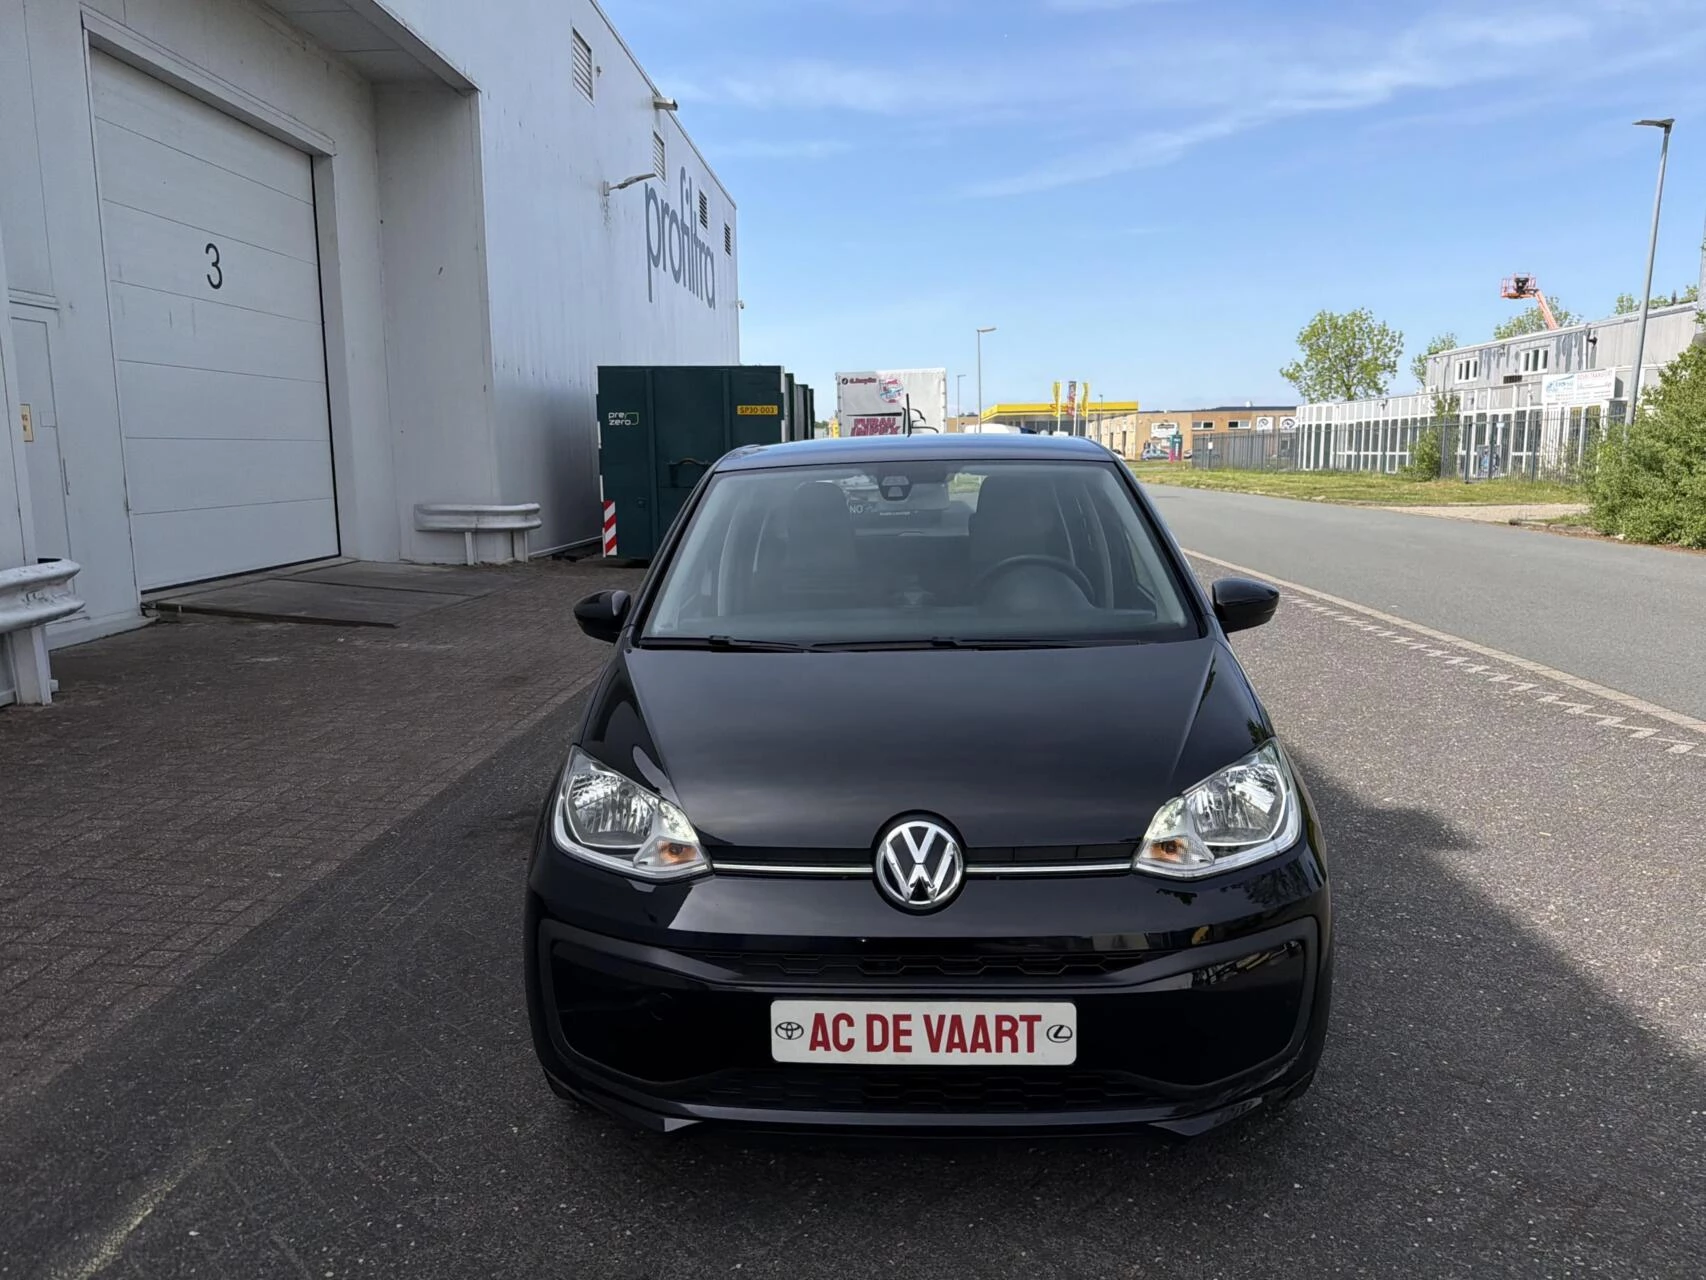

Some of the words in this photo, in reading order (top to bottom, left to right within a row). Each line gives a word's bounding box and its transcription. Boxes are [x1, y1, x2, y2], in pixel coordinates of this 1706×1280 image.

[644, 166, 715, 311] profiltra
[205, 243, 223, 289] 3
[608, 412, 625, 420] pre
[608, 418, 632, 426] zero
[809, 1012, 856, 1052] AC
[866, 1013, 912, 1053] DE
[923, 1014, 1042, 1053] VAART
